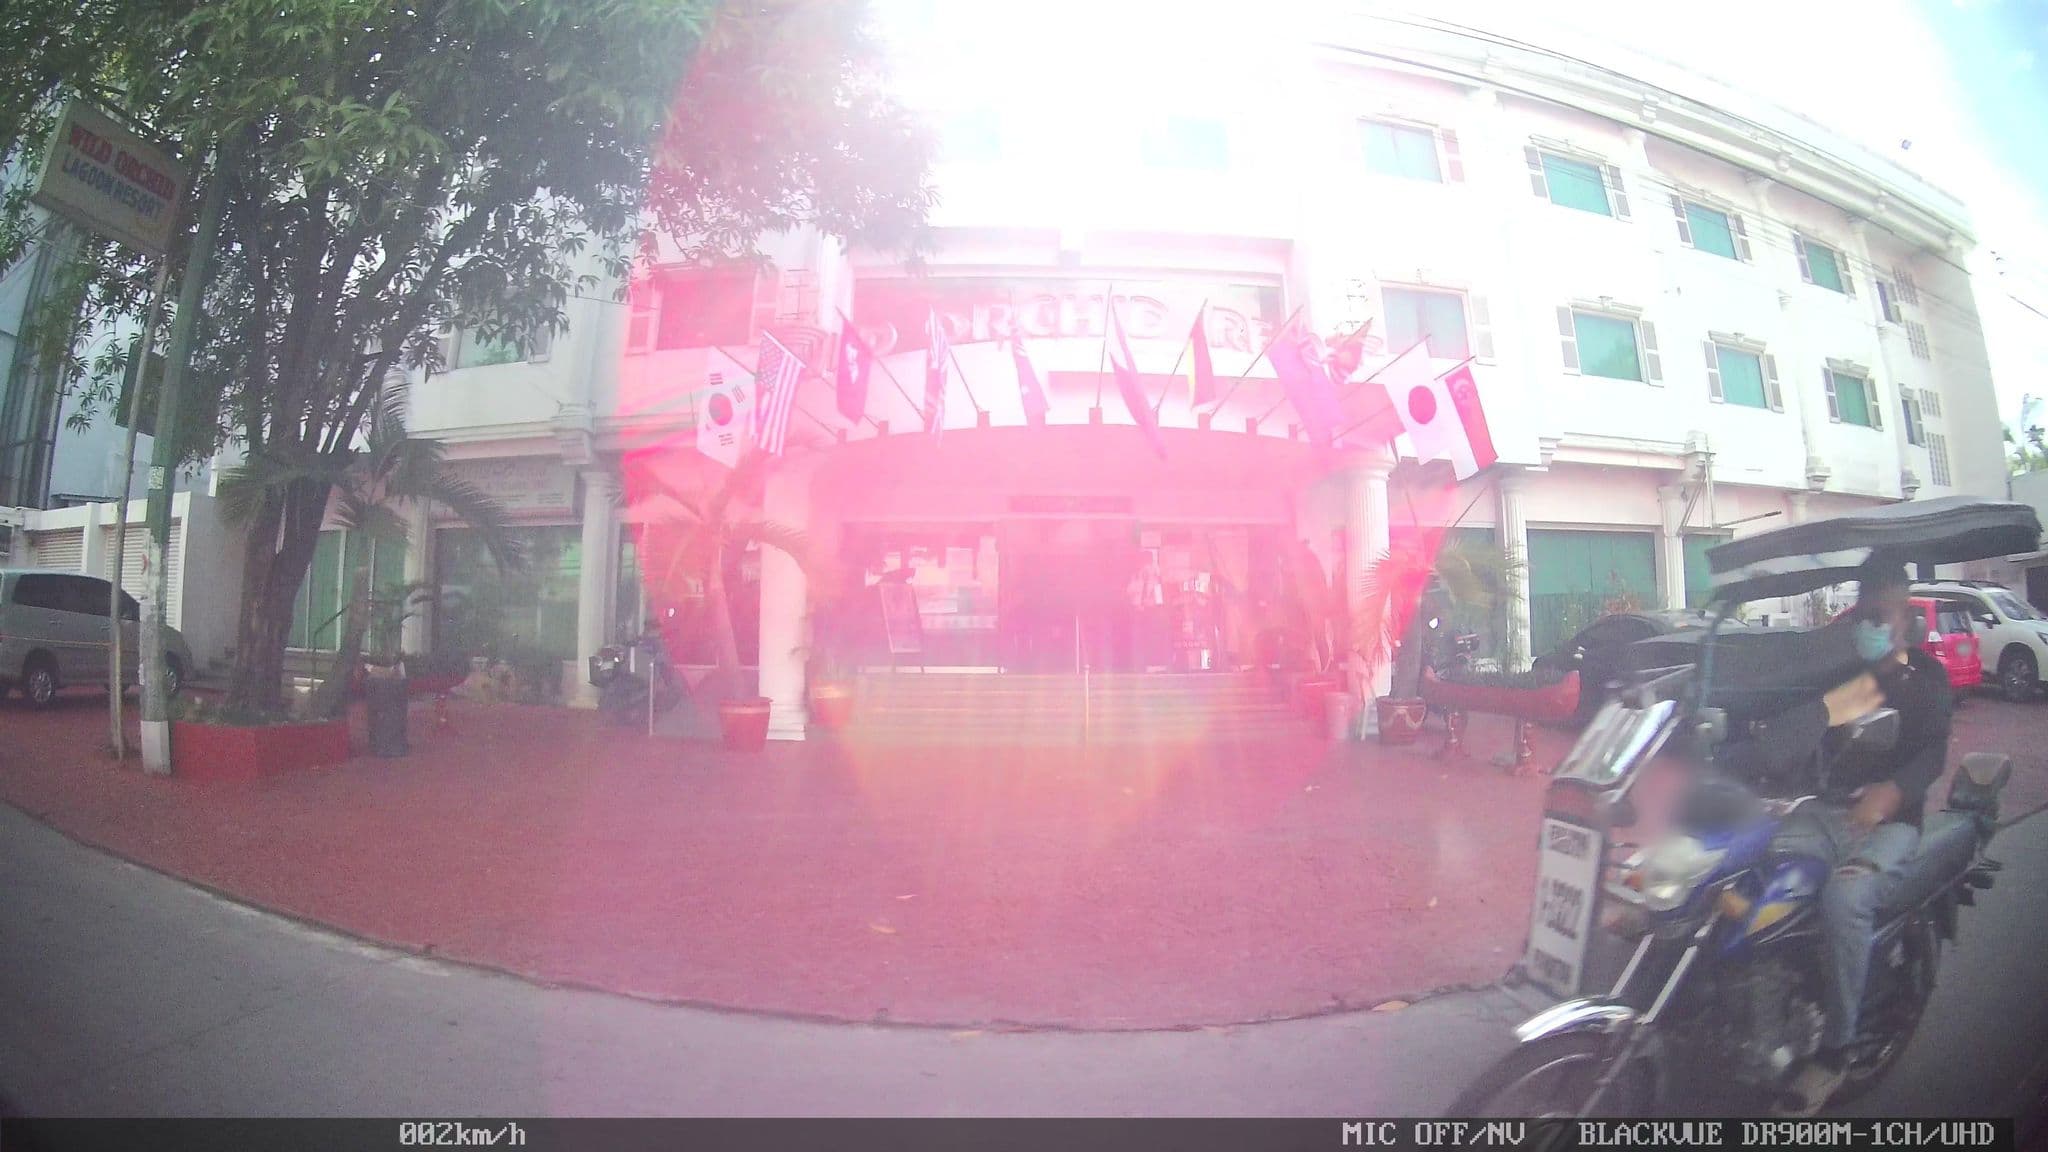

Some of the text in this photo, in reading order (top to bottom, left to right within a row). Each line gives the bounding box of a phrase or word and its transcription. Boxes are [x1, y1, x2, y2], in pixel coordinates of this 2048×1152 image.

[69, 124, 113, 164] WILD
[62, 152, 164, 220] LAGOON RESORT
